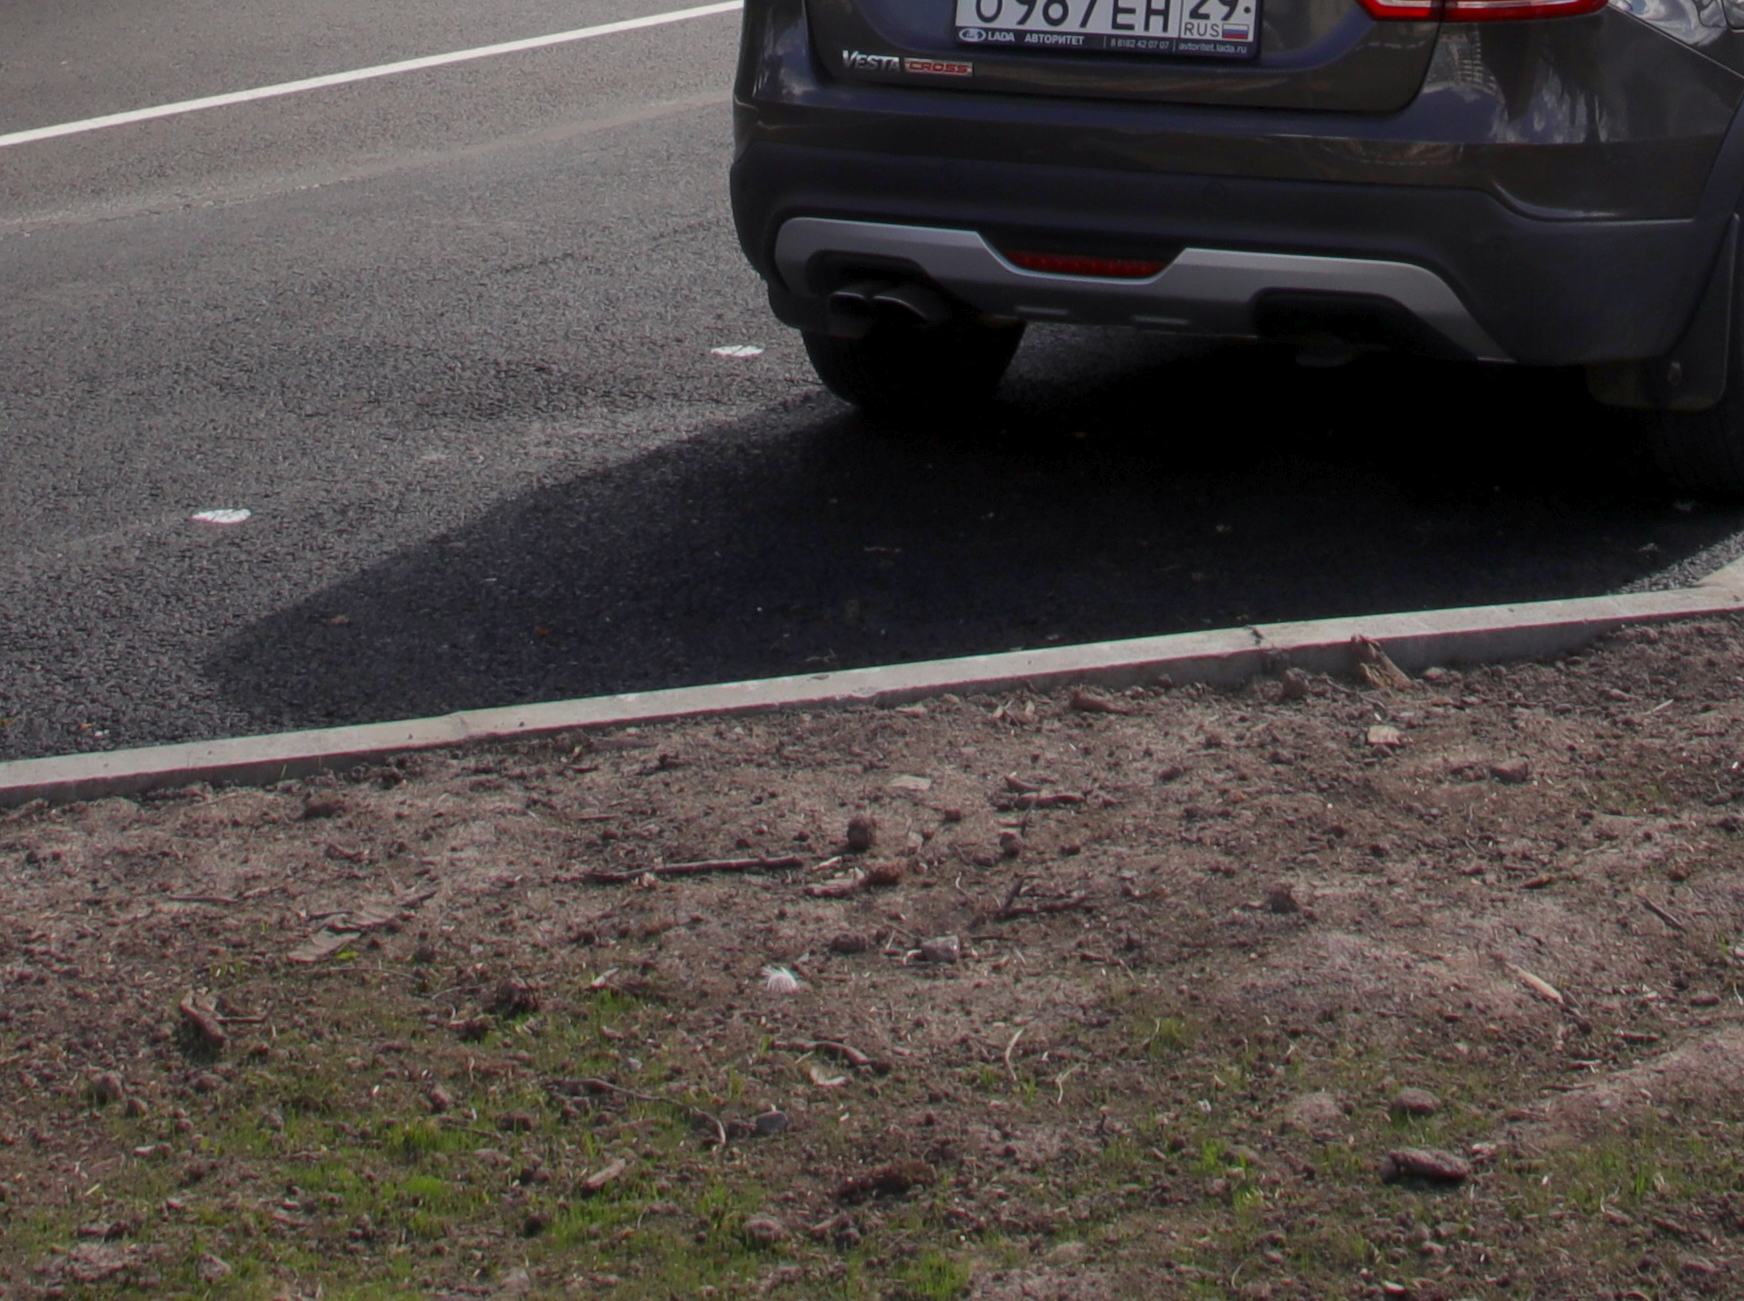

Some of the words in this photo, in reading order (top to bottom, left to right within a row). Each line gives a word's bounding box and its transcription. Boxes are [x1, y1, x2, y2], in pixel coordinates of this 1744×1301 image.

[1183, 21, 1220, 38] RUS
[987, 31, 1016, 43] LADA
[1024, 33, 1085, 46] АВТОРИТЕТ
[842, 50, 901, 72] VESTA
[909, 60, 971, 75] CROSS
